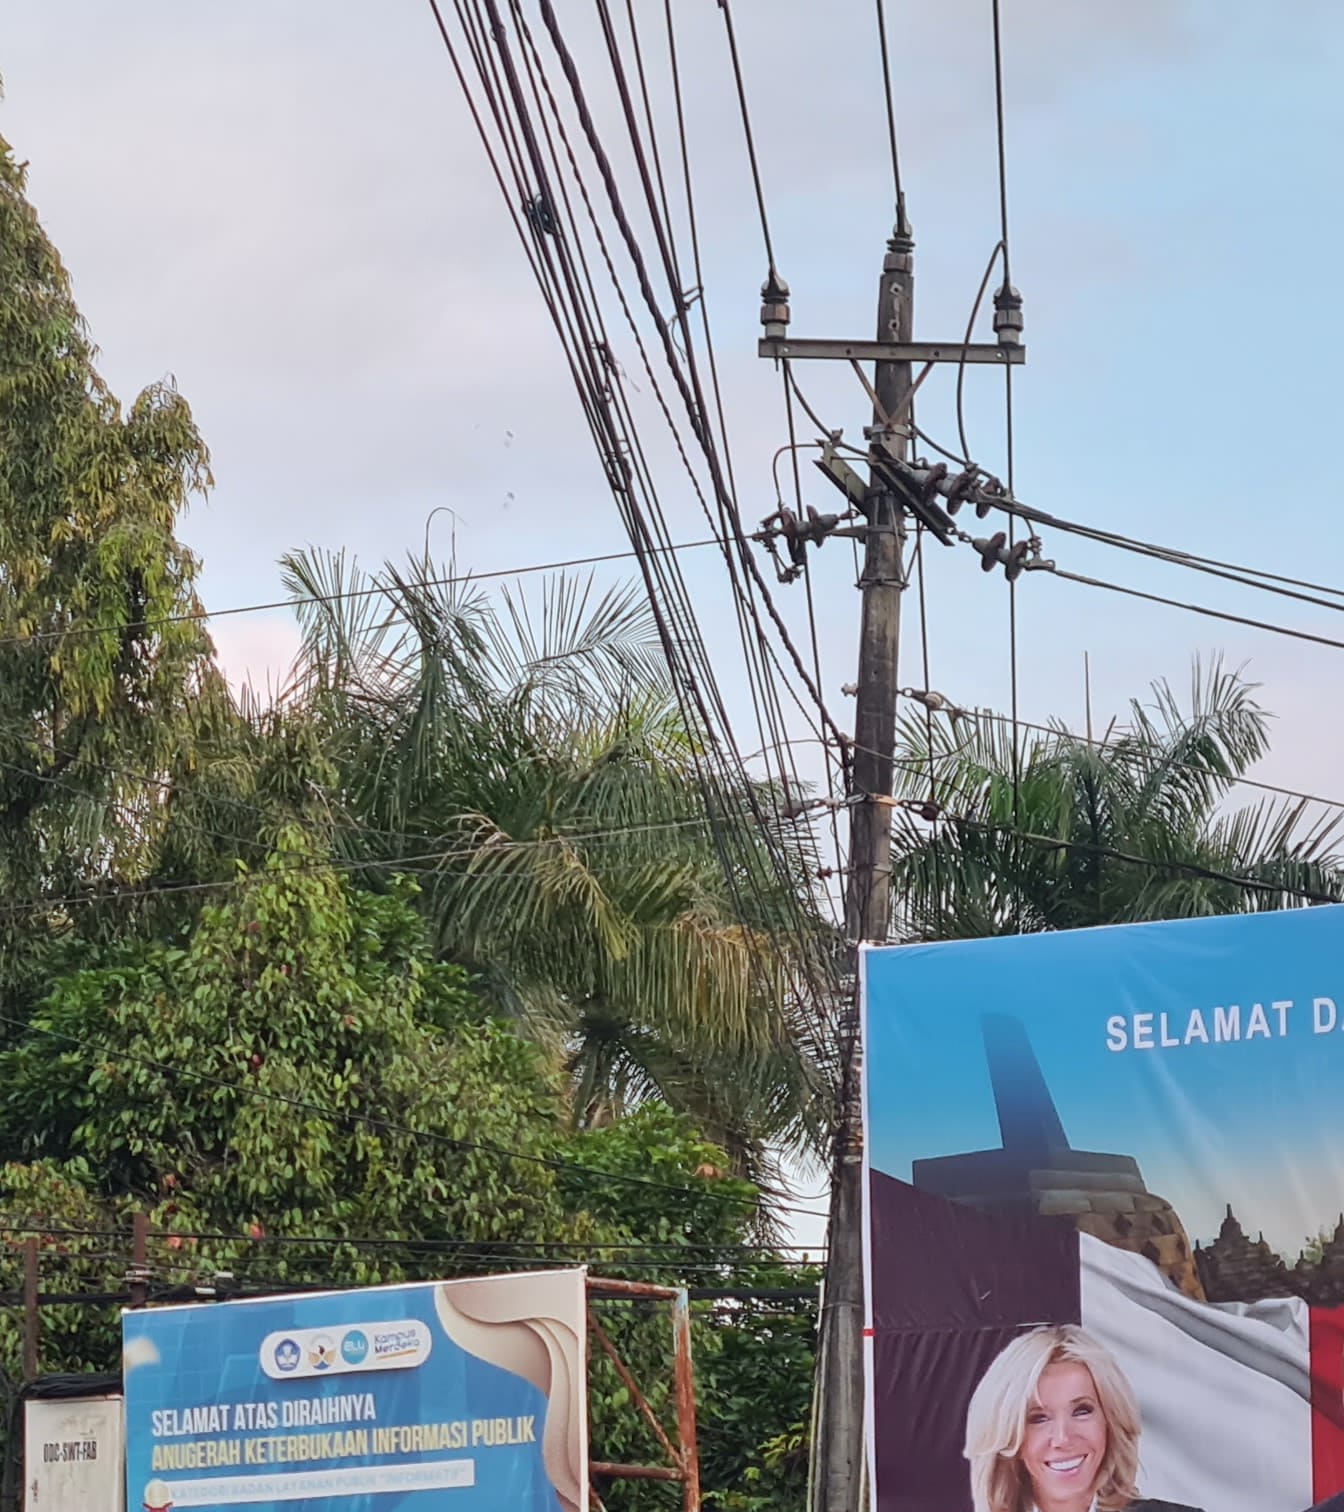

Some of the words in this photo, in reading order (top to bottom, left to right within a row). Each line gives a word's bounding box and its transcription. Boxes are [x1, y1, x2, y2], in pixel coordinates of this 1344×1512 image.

[1106, 1001, 1293, 1052] SELAMAT
[152, 1402, 228, 1437] SELAMAT
[234, 1399, 278, 1431] ATAS
[283, 1393, 376, 1428] DIRAIHNYA
[152, 1437, 240, 1471] ANUGERAH
[244, 1430, 369, 1466] KETERBUKAAN
[372, 1420, 467, 1455] INFORMASI
[472, 1415, 536, 1447] PUBLIK
